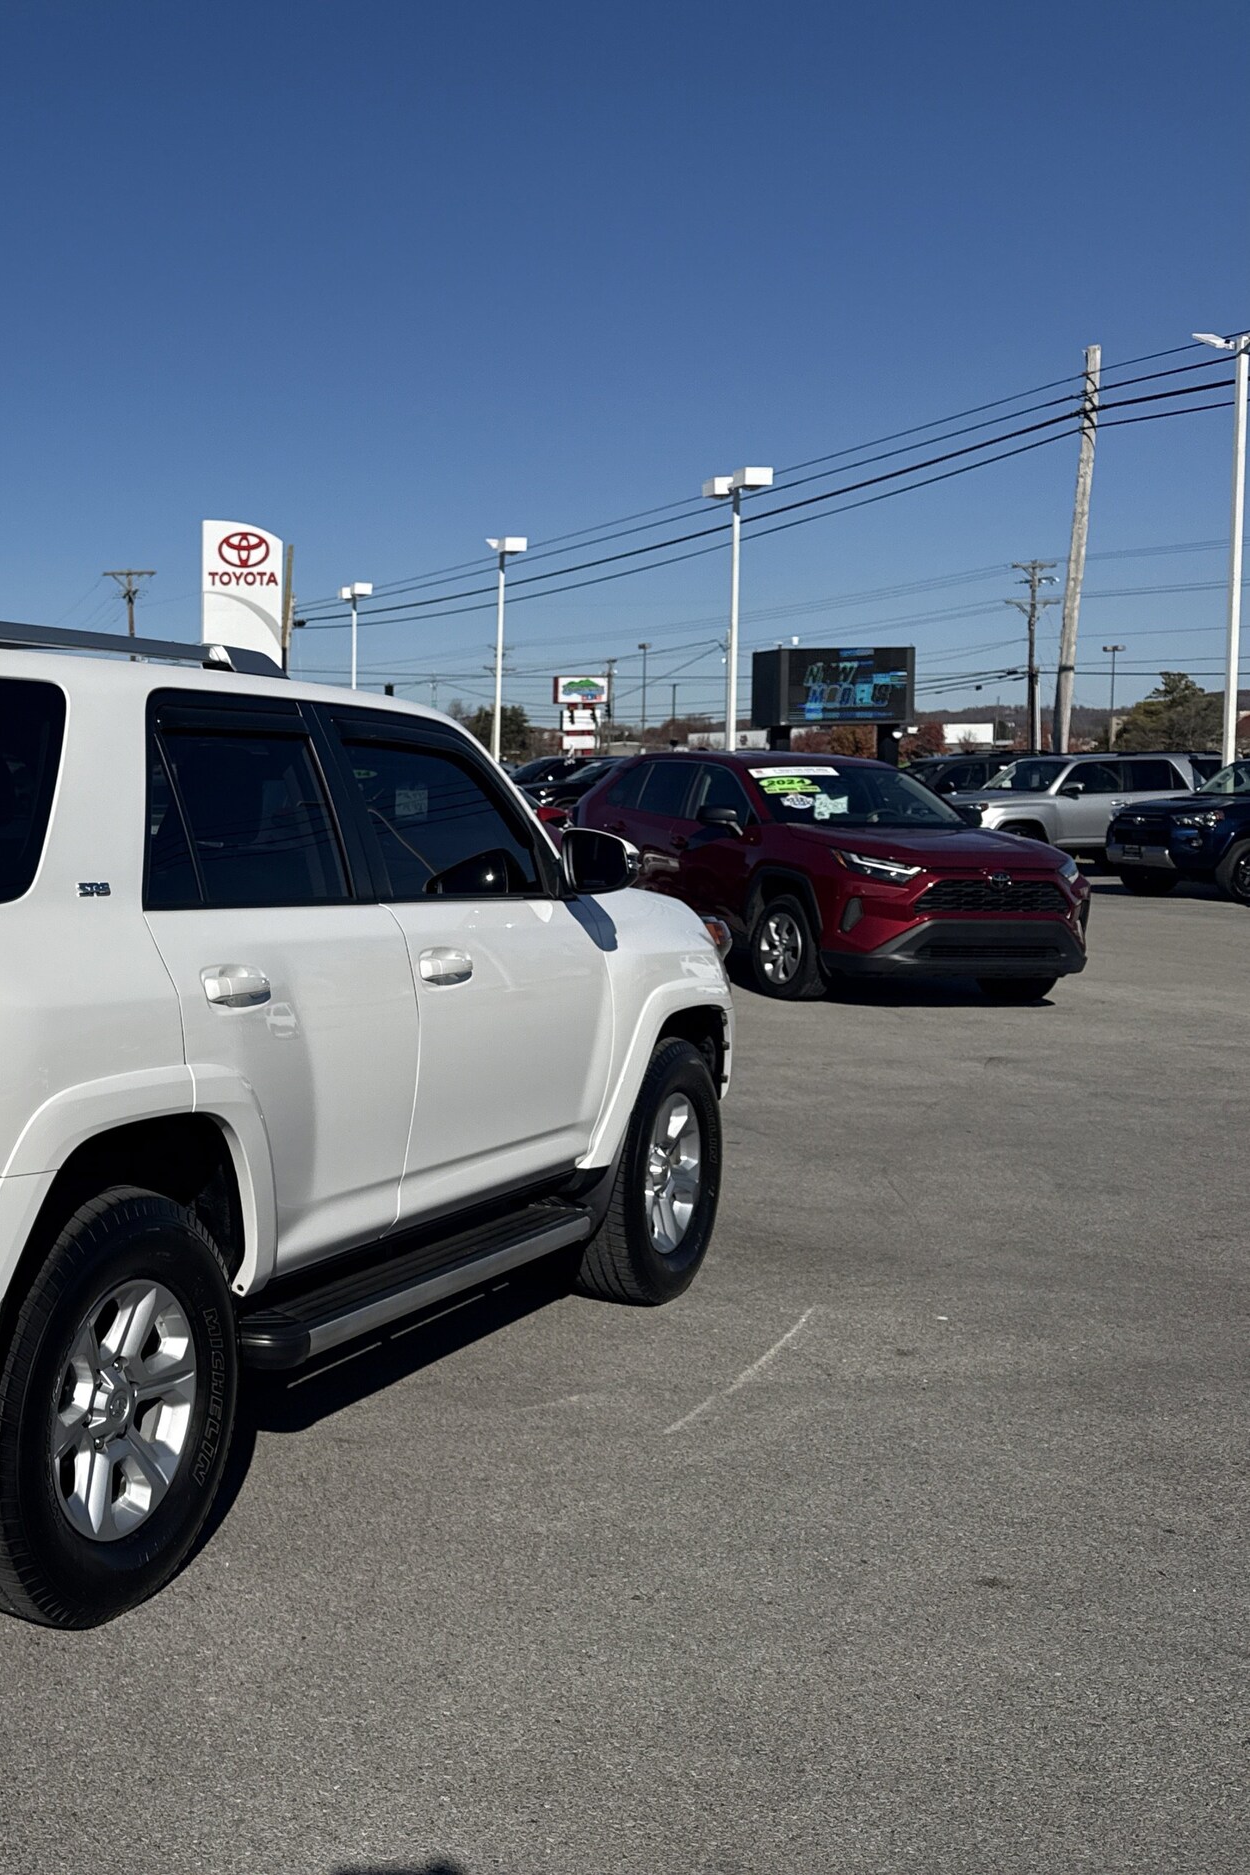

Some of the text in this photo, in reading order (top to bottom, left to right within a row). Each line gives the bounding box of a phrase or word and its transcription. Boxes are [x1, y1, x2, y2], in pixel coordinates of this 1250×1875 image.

[209, 571, 278, 586] TOYOTA
[767, 778, 806, 787] 2024
[192, 1307, 225, 1487] MICHELIN
